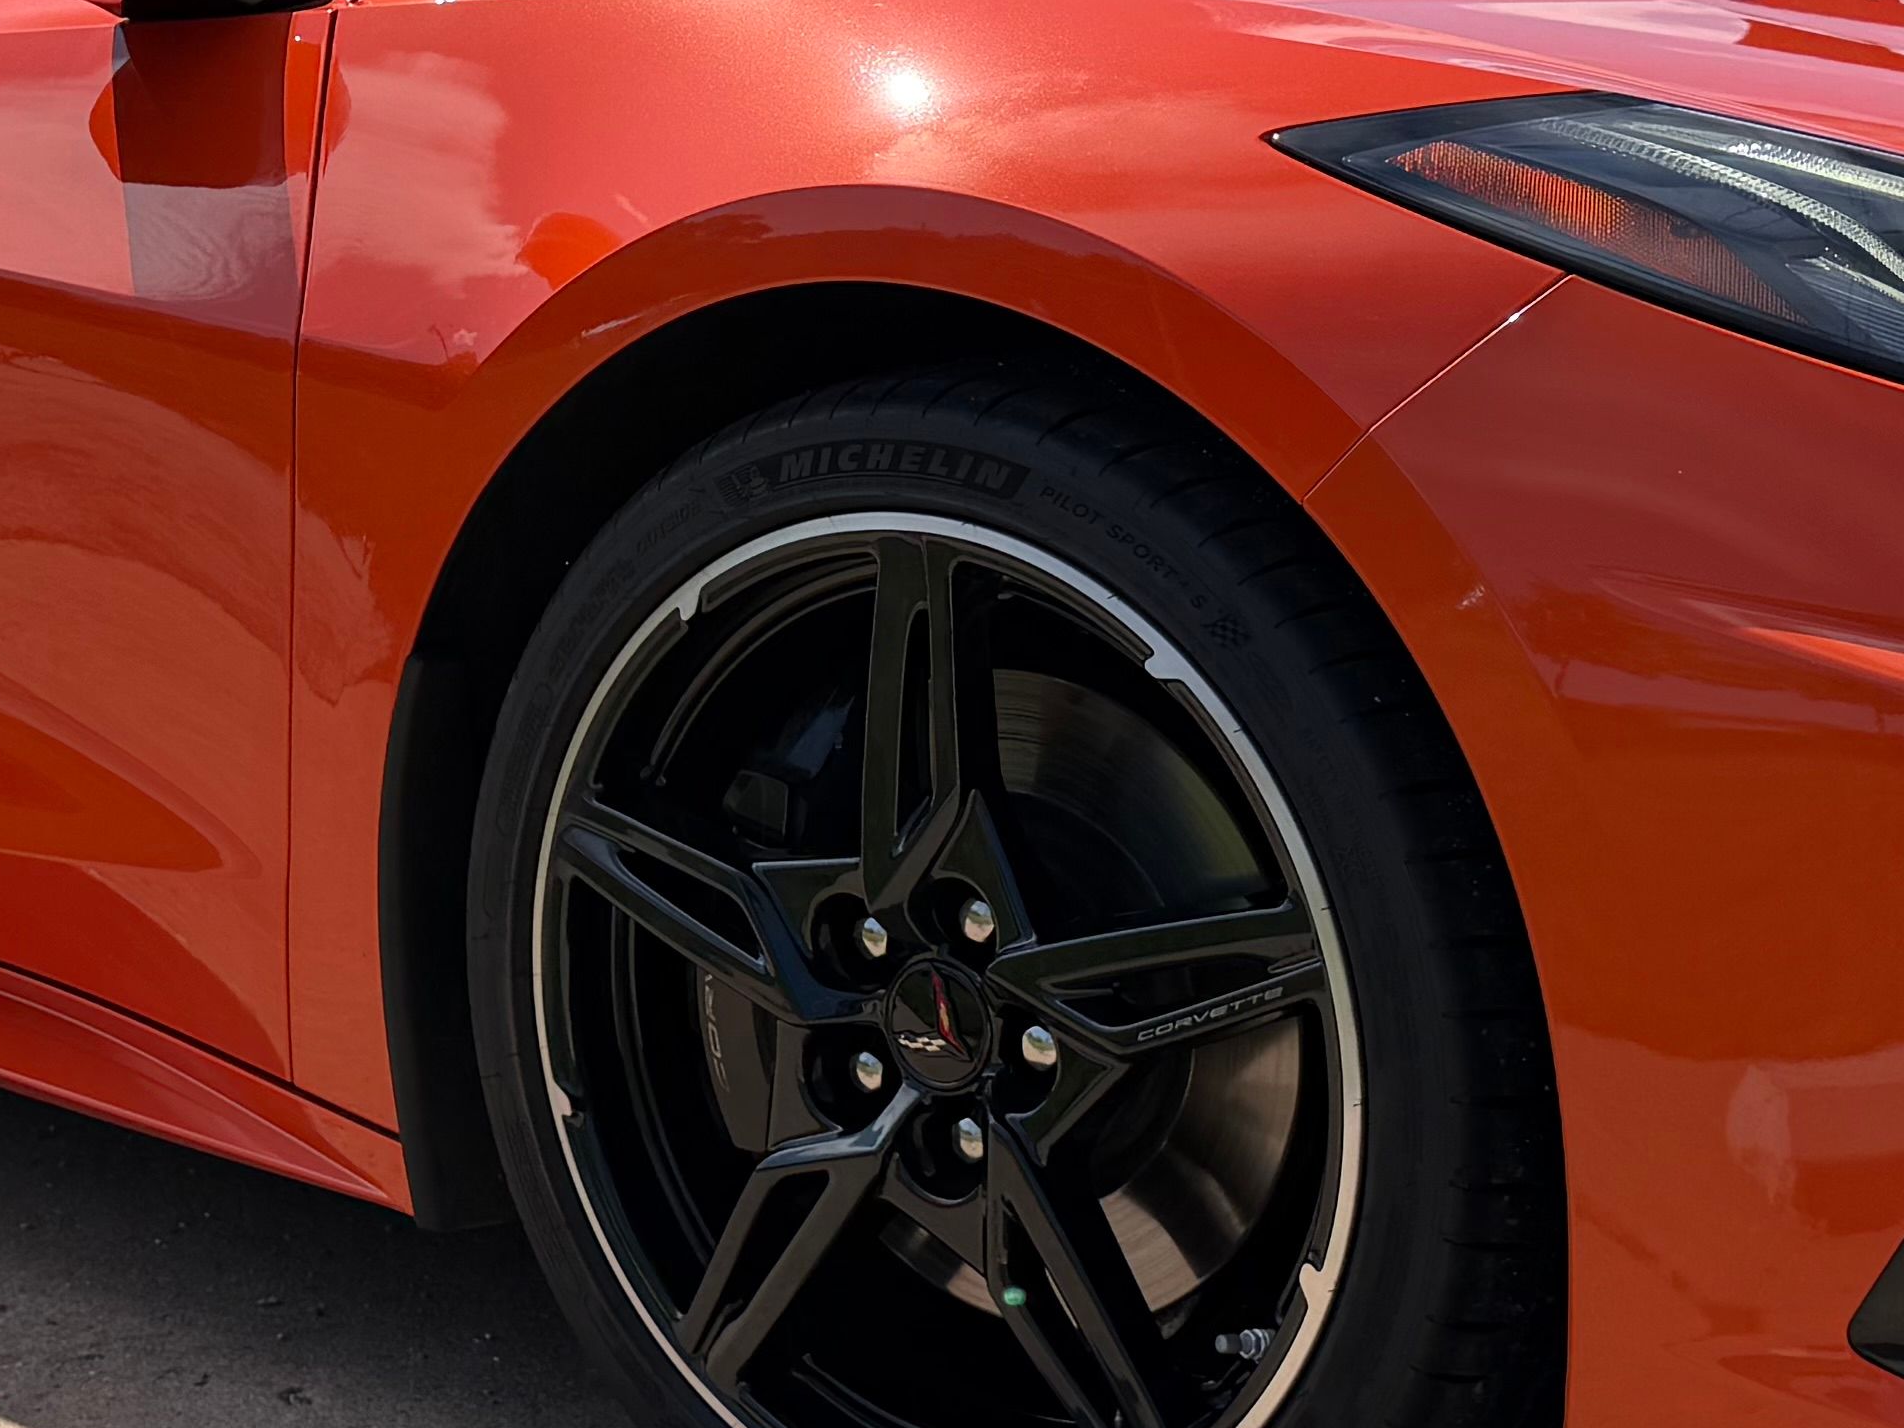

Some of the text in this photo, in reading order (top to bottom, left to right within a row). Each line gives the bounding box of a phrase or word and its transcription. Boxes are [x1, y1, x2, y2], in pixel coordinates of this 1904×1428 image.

[779, 443, 1010, 490] MICHELIN
[1039, 485, 1104, 525] PILOT
[1105, 524, 1179, 579] SPORT
[1136, 985, 1284, 1042] CORVETTE
